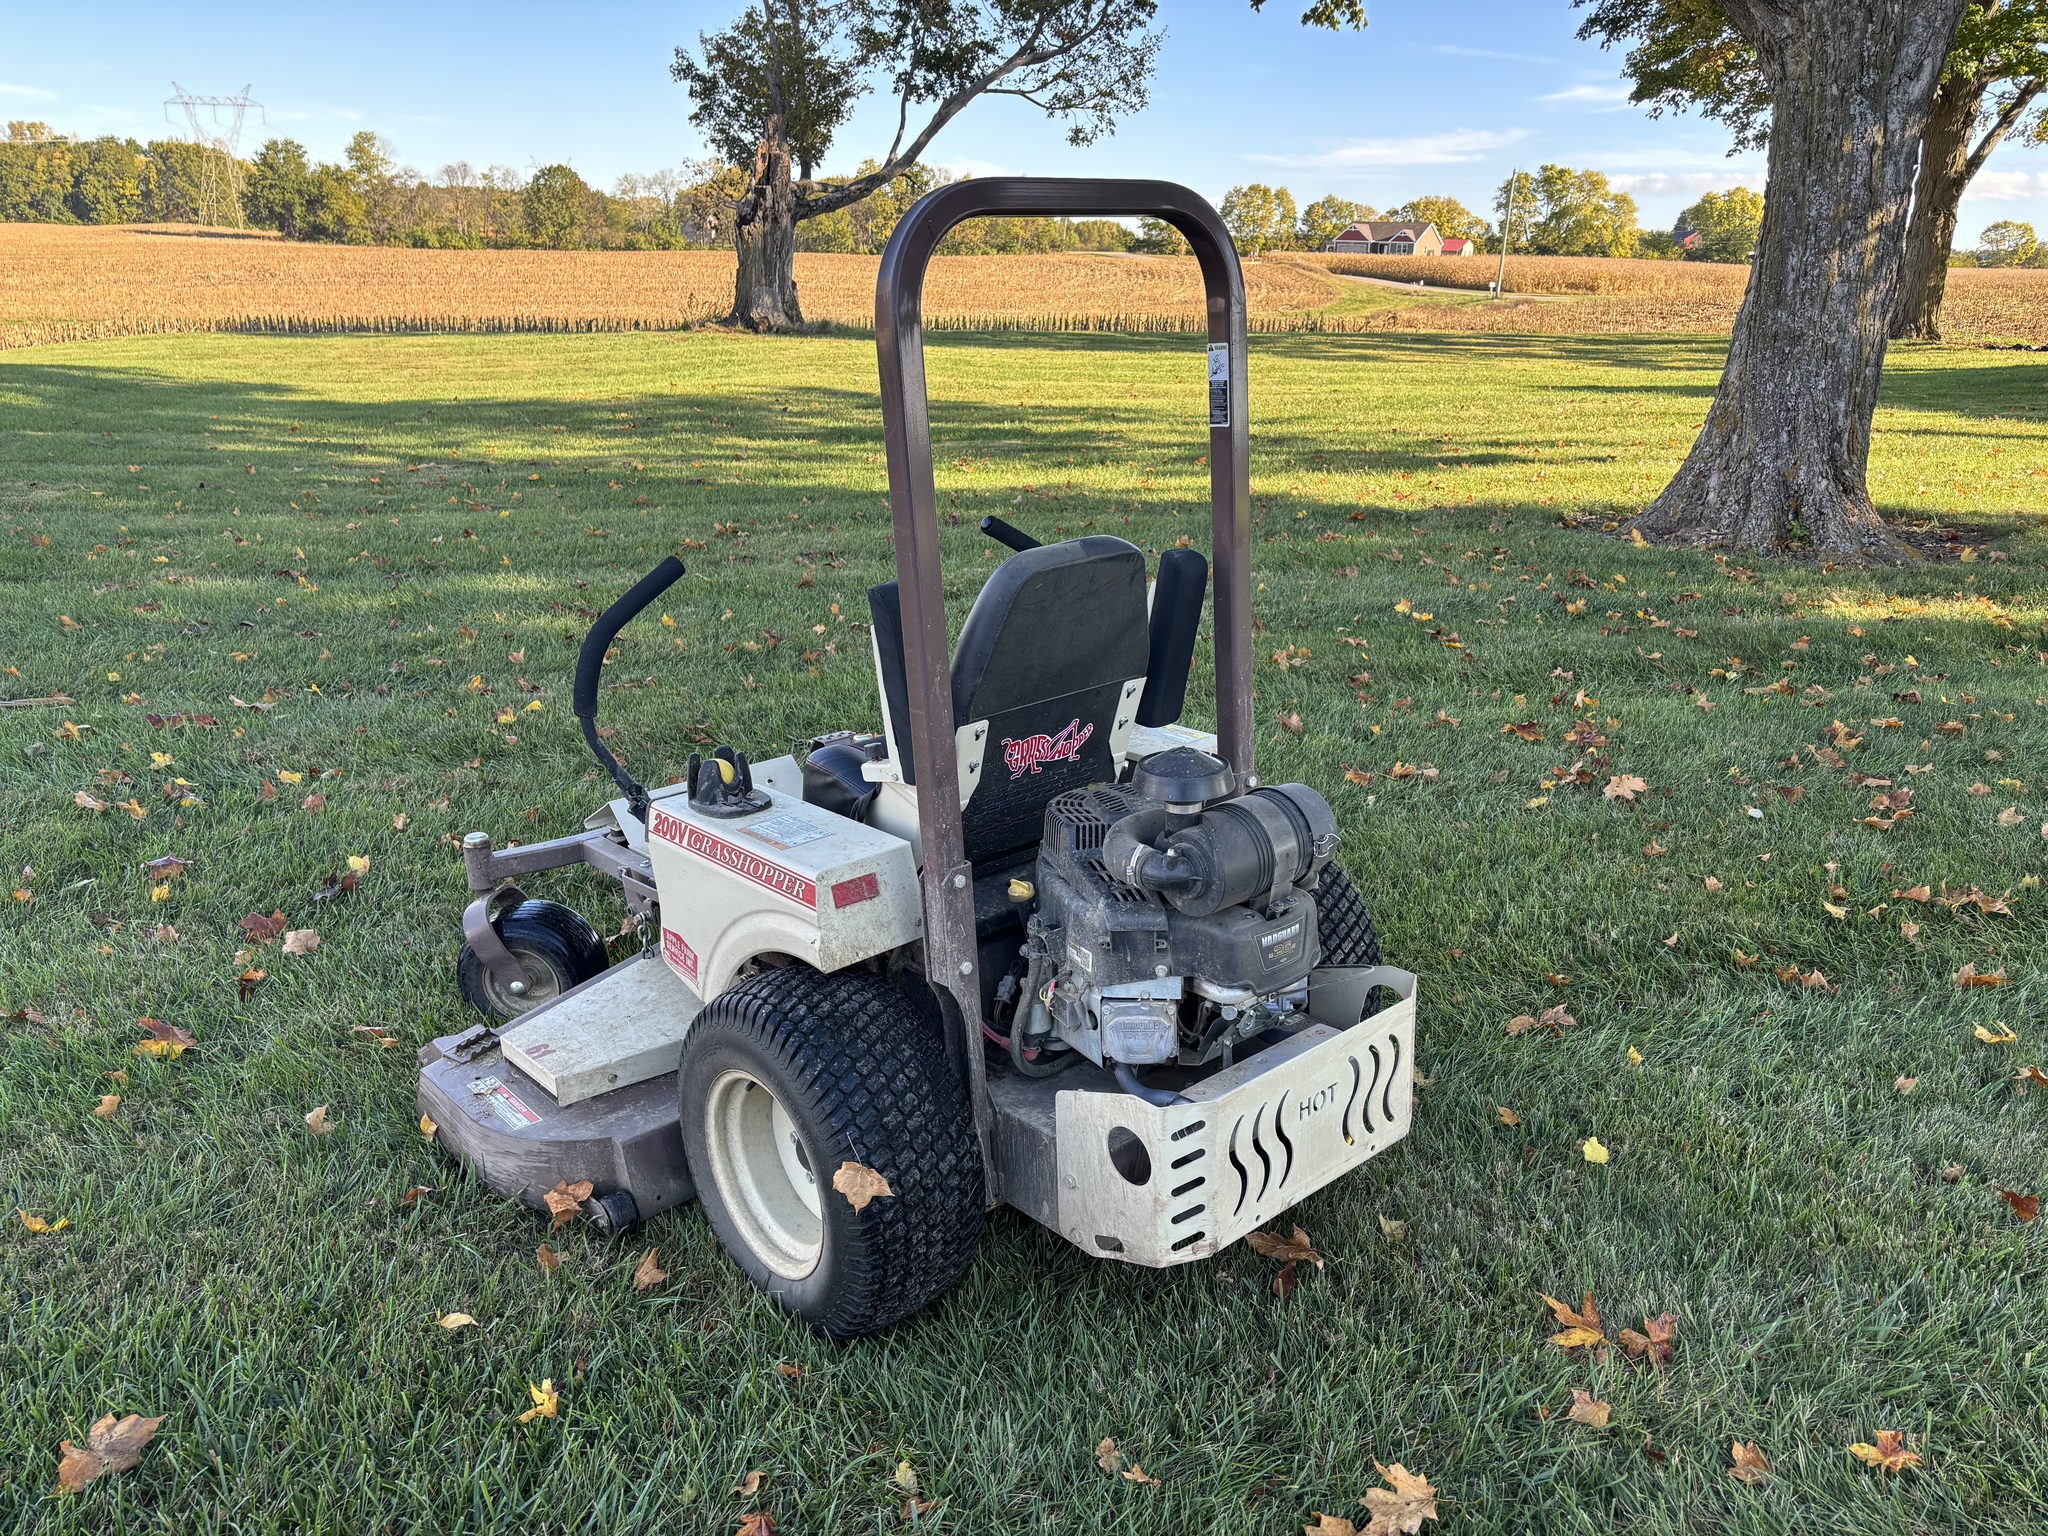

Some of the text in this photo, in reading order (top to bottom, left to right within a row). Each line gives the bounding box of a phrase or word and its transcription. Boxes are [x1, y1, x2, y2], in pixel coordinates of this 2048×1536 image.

[1001, 718, 1094, 780] GRASSHOPPER
[653, 812, 688, 845] 200V
[690, 832, 806, 900] GRASSHOPPER
[1261, 923, 1300, 948] VANGUARD
[1299, 1081, 1339, 1121] HOT
